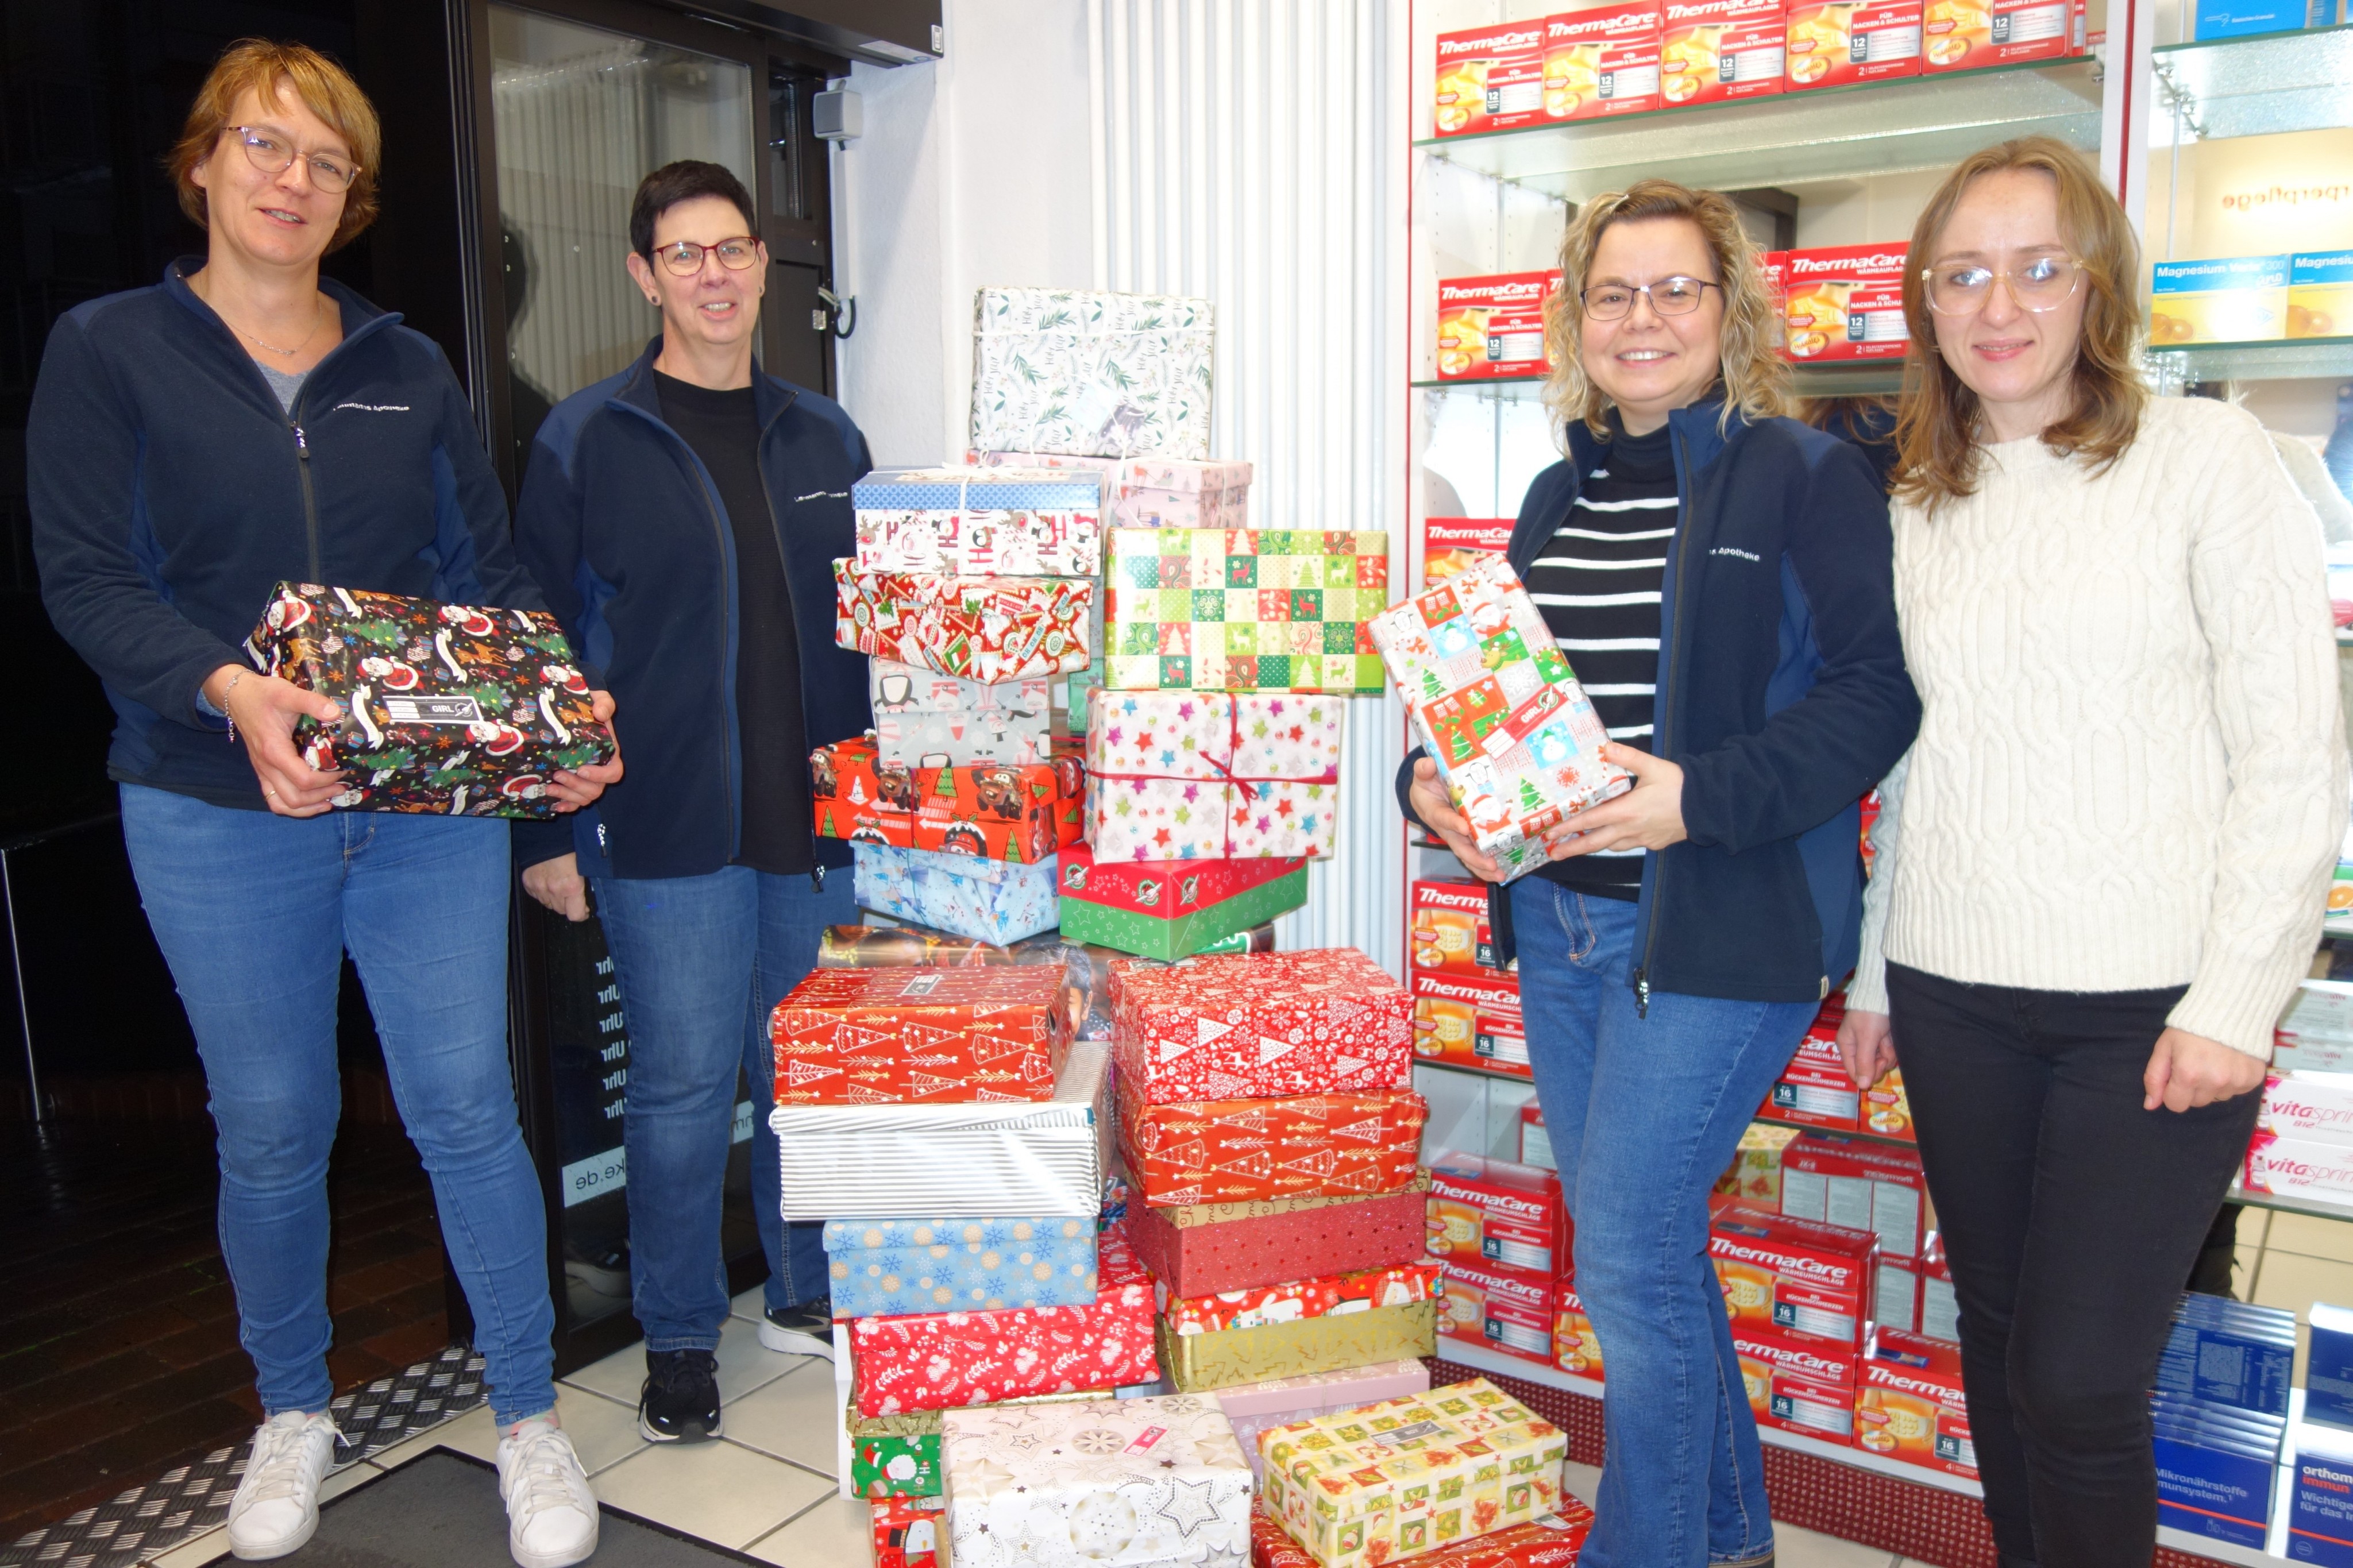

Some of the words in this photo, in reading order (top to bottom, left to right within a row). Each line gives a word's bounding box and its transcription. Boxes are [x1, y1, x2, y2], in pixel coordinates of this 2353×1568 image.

[1727, 3, 1779, 16] WÄRMEAUFLAGEN
[1995, 1, 2021, 9] NACKEN
[1548, 12, 1657, 37] ThermaCare
[1853, 20, 1880, 29] NACKEN
[1886, 15, 1919, 25] SCHULTER
[1995, 18, 2008, 28] 12
[1440, 32, 1540, 55] ThermaCare
[1722, 42, 1746, 50] NACKEN
[1752, 36, 1783, 46] SCHULTER
[1853, 38, 1865, 47] 12
[2000, 48, 2007, 57] 2
[1722, 59, 1733, 67] 12
[1858, 67, 1865, 76] 2
[1600, 76, 1612, 85] 12
[1488, 92, 1499, 101] 12
[1726, 87, 1733, 95] 2
[1605, 103, 1611, 111] 2
[2157, 264, 2225, 278] Magnesium
[2266, 260, 2284, 269] 300
[1441, 283, 1541, 300] ThermaCare
[1851, 317, 1862, 326] 12
[1718, 547, 1760, 561] Apotheke
[1521, 706, 1543, 723] GIRL
[1480, 949, 1491, 957] 16
[1479, 1039, 1489, 1048] 16
[1787, 1073, 1845, 1087] RÜCKENSCHMERZEN
[1780, 1089, 1791, 1098] 16
[1430, 1181, 1544, 1214] ThermaCare
[1486, 1205, 1541, 1221] WÄRMEUMSCHLÄGE
[1487, 1242, 1497, 1250] 16
[1711, 1237, 1849, 1279] ThermaCare
[1435, 1258, 1544, 1298] ThermaCare
[1779, 1266, 1845, 1285] WÄRMEUMSCHLÄGE
[1786, 1293, 1843, 1311] RÜCKENSCHMERZEN
[1779, 1307, 1791, 1317] 16
[1488, 1323, 1498, 1331] 16
[1734, 1339, 1845, 1373] ermaCare
[1776, 1360, 1841, 1380] WÄRMEUMSCHLÄGE
[1868, 1365, 1966, 1400] Therma
[1784, 1387, 1840, 1405] RÜCKENSCHMERZEN
[1777, 1400, 1788, 1409] 16
[1780, 1421, 1787, 1429] 4
[1942, 1439, 1953, 1449] 16
[2302, 1476, 2350, 1493] immun
[2300, 1501, 2319, 1513] für
[2320, 1505, 2342, 1519] das
